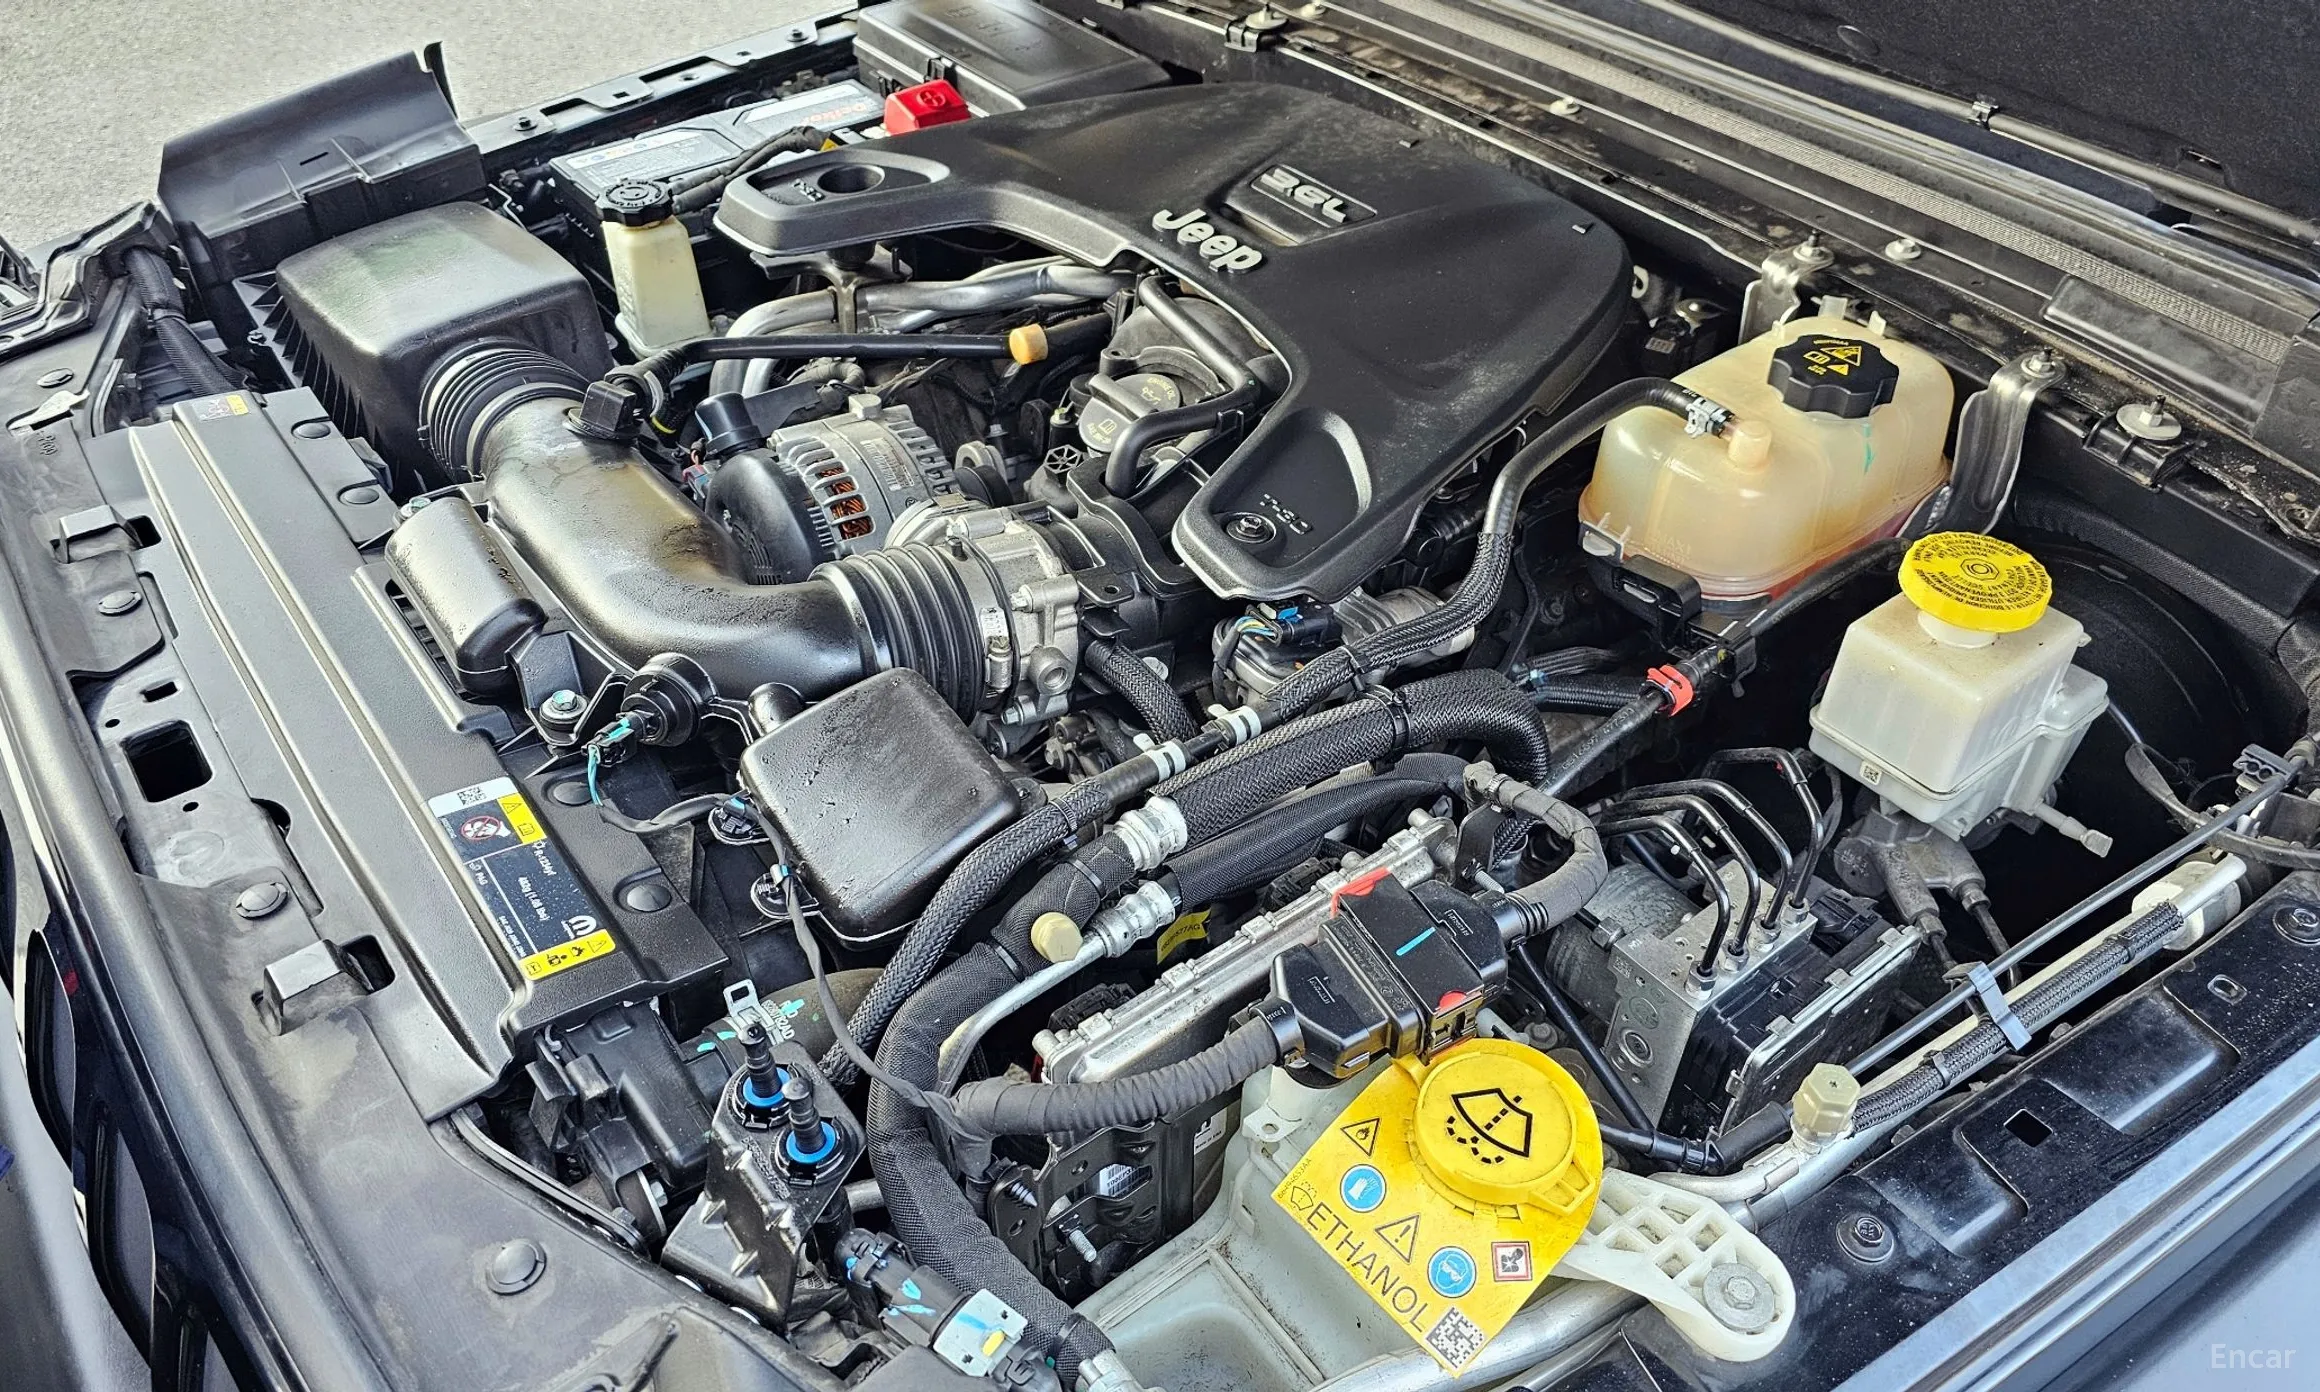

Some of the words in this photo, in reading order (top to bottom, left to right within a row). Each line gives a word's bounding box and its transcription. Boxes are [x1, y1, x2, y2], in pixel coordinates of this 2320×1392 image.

[1260, 168, 1348, 223] 3.6L
[1152, 208, 1263, 273] Jeep
[1306, 1201, 1428, 1333] ETHANOL
